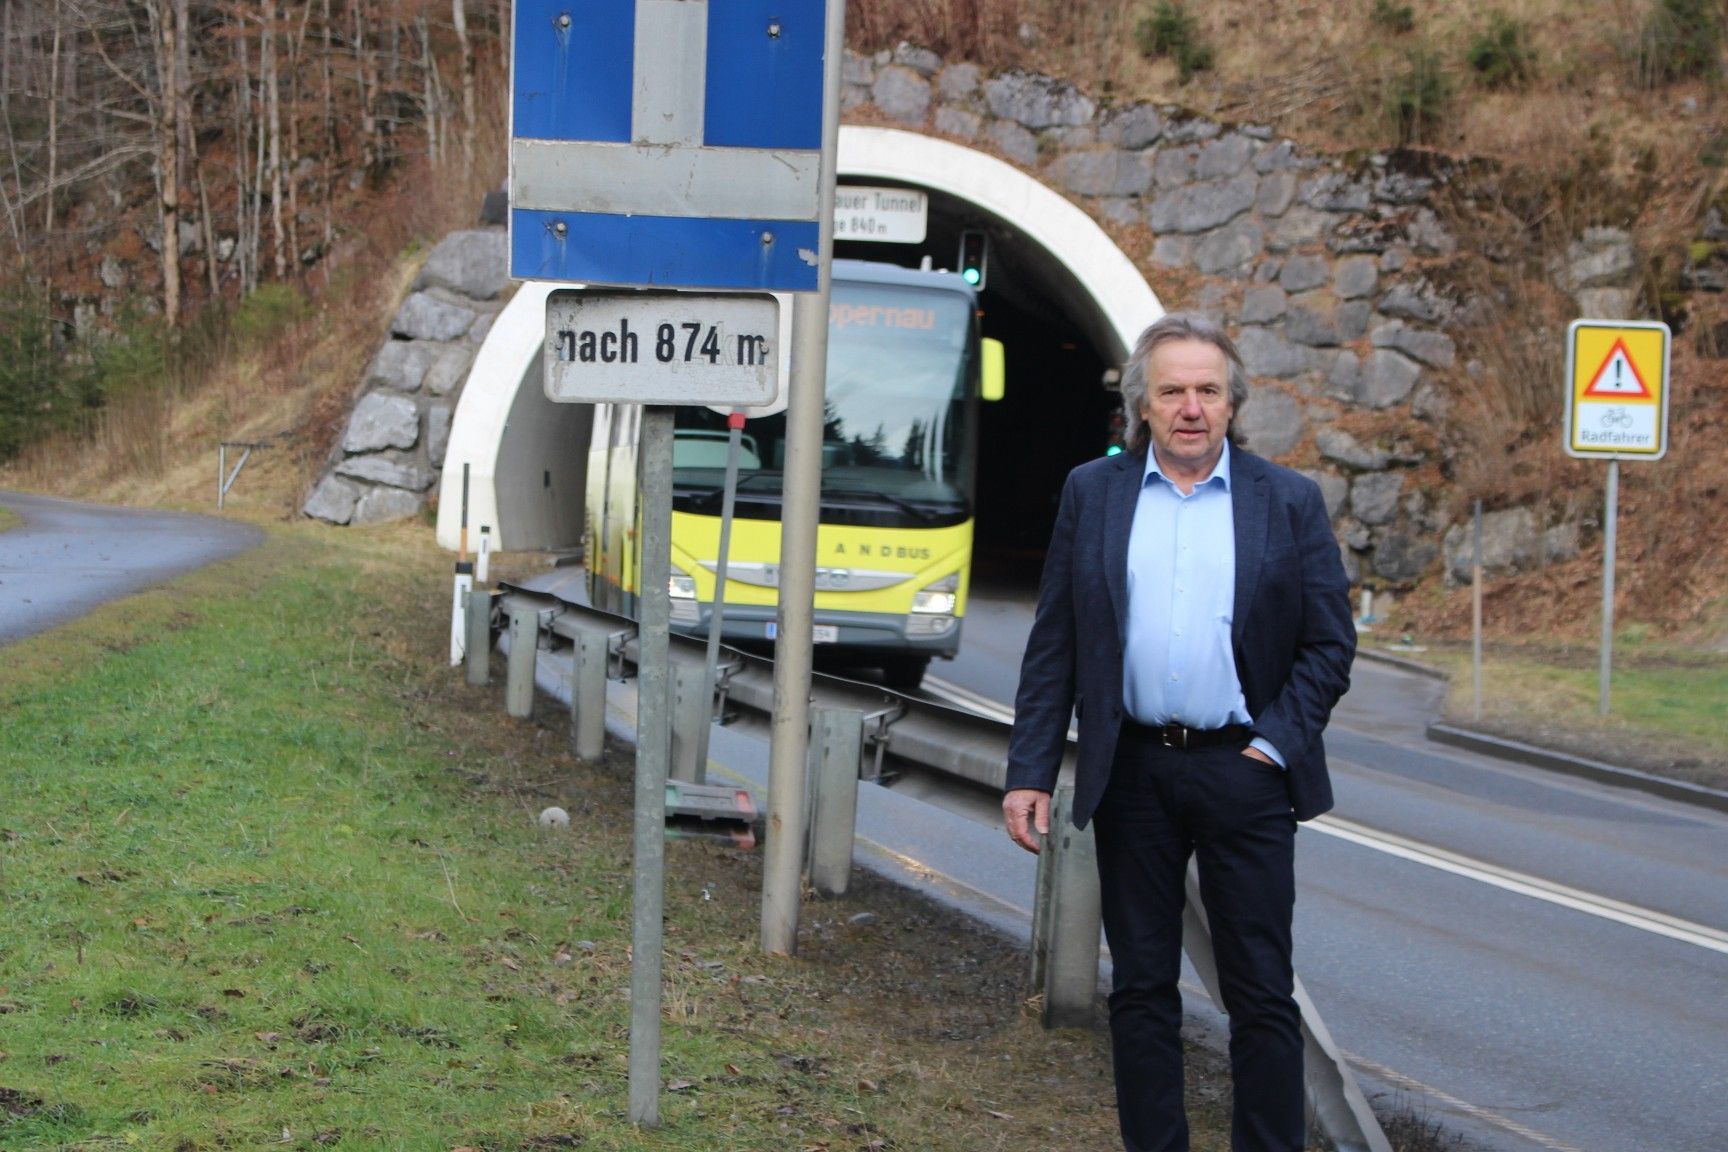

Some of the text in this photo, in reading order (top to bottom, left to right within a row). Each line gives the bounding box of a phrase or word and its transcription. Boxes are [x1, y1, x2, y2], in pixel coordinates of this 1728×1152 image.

[834, 191, 922, 212] auer Tunnel
[877, 223, 888, 233] m
[558, 318, 766, 366] nach 874 m
[1581, 430, 1650, 444] Radfahrer
[834, 543, 931, 560] ANDBUS
